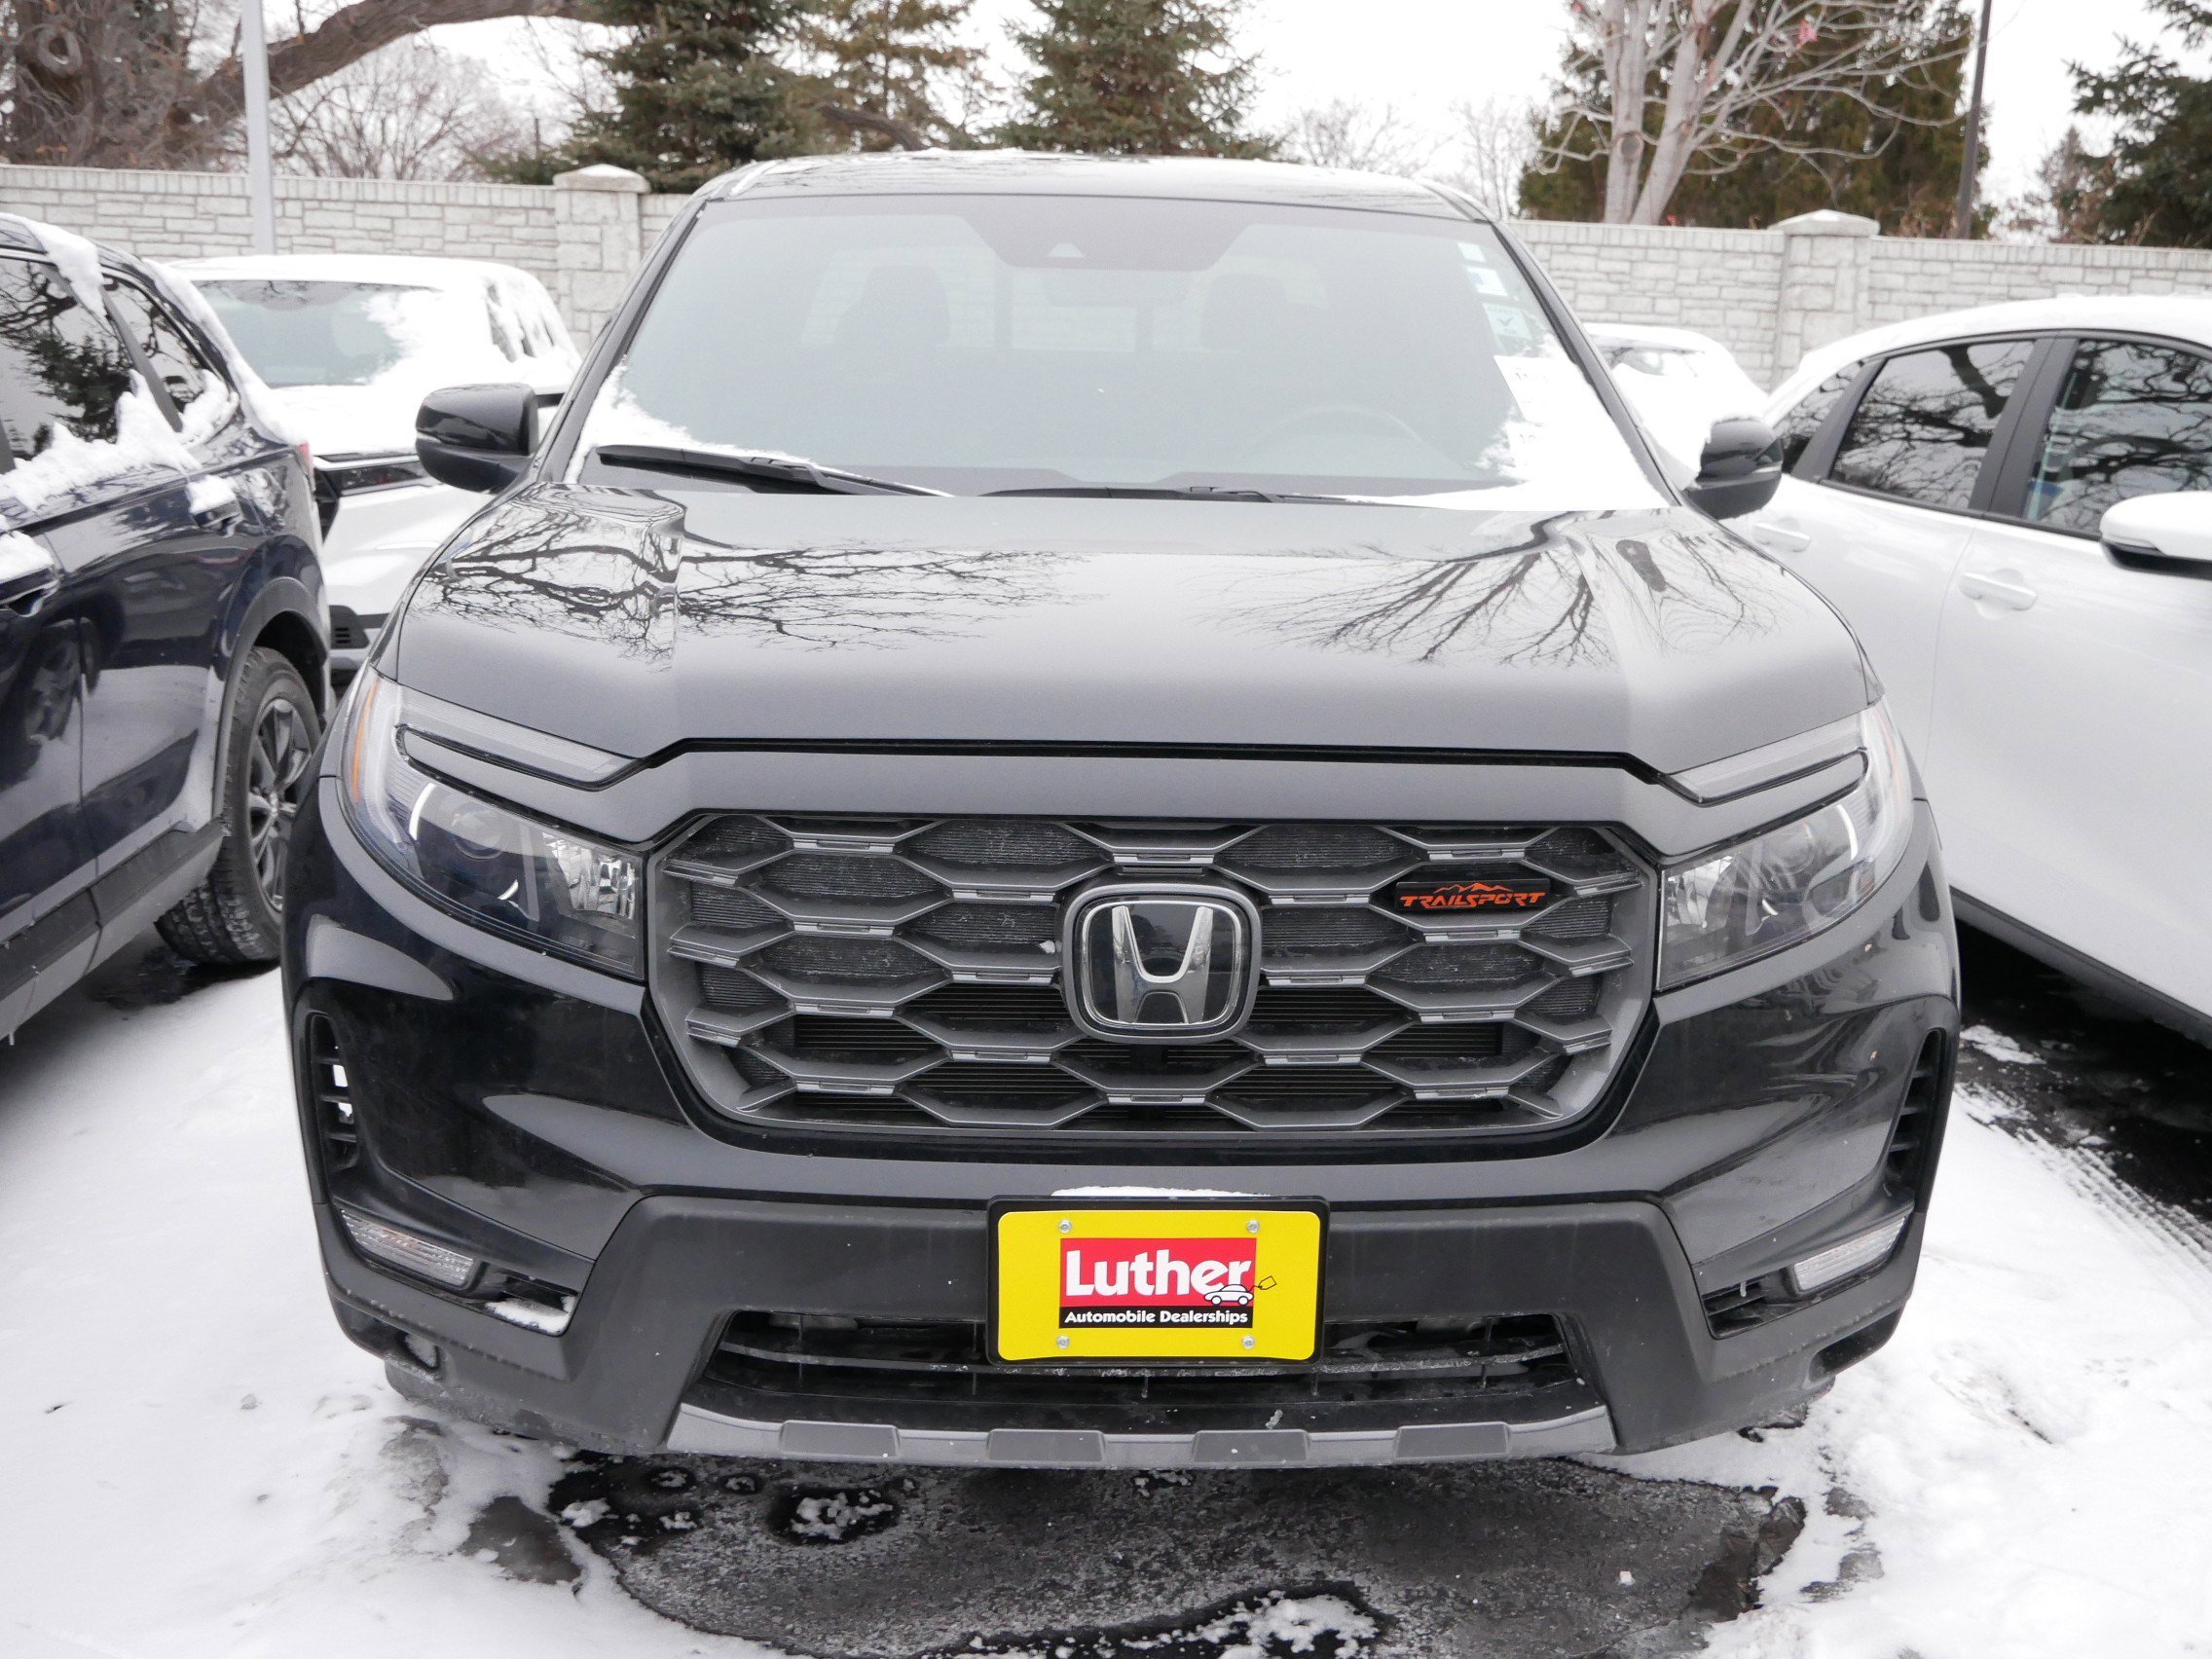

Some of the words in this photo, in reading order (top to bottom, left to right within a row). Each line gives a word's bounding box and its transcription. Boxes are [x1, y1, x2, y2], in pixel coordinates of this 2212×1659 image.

[1400, 892, 1546, 909] TRAILSPORT
[1066, 1249, 1252, 1297] Luther
[1064, 1309, 1156, 1324] Automobile
[1160, 1309, 1248, 1325] Dealerships
